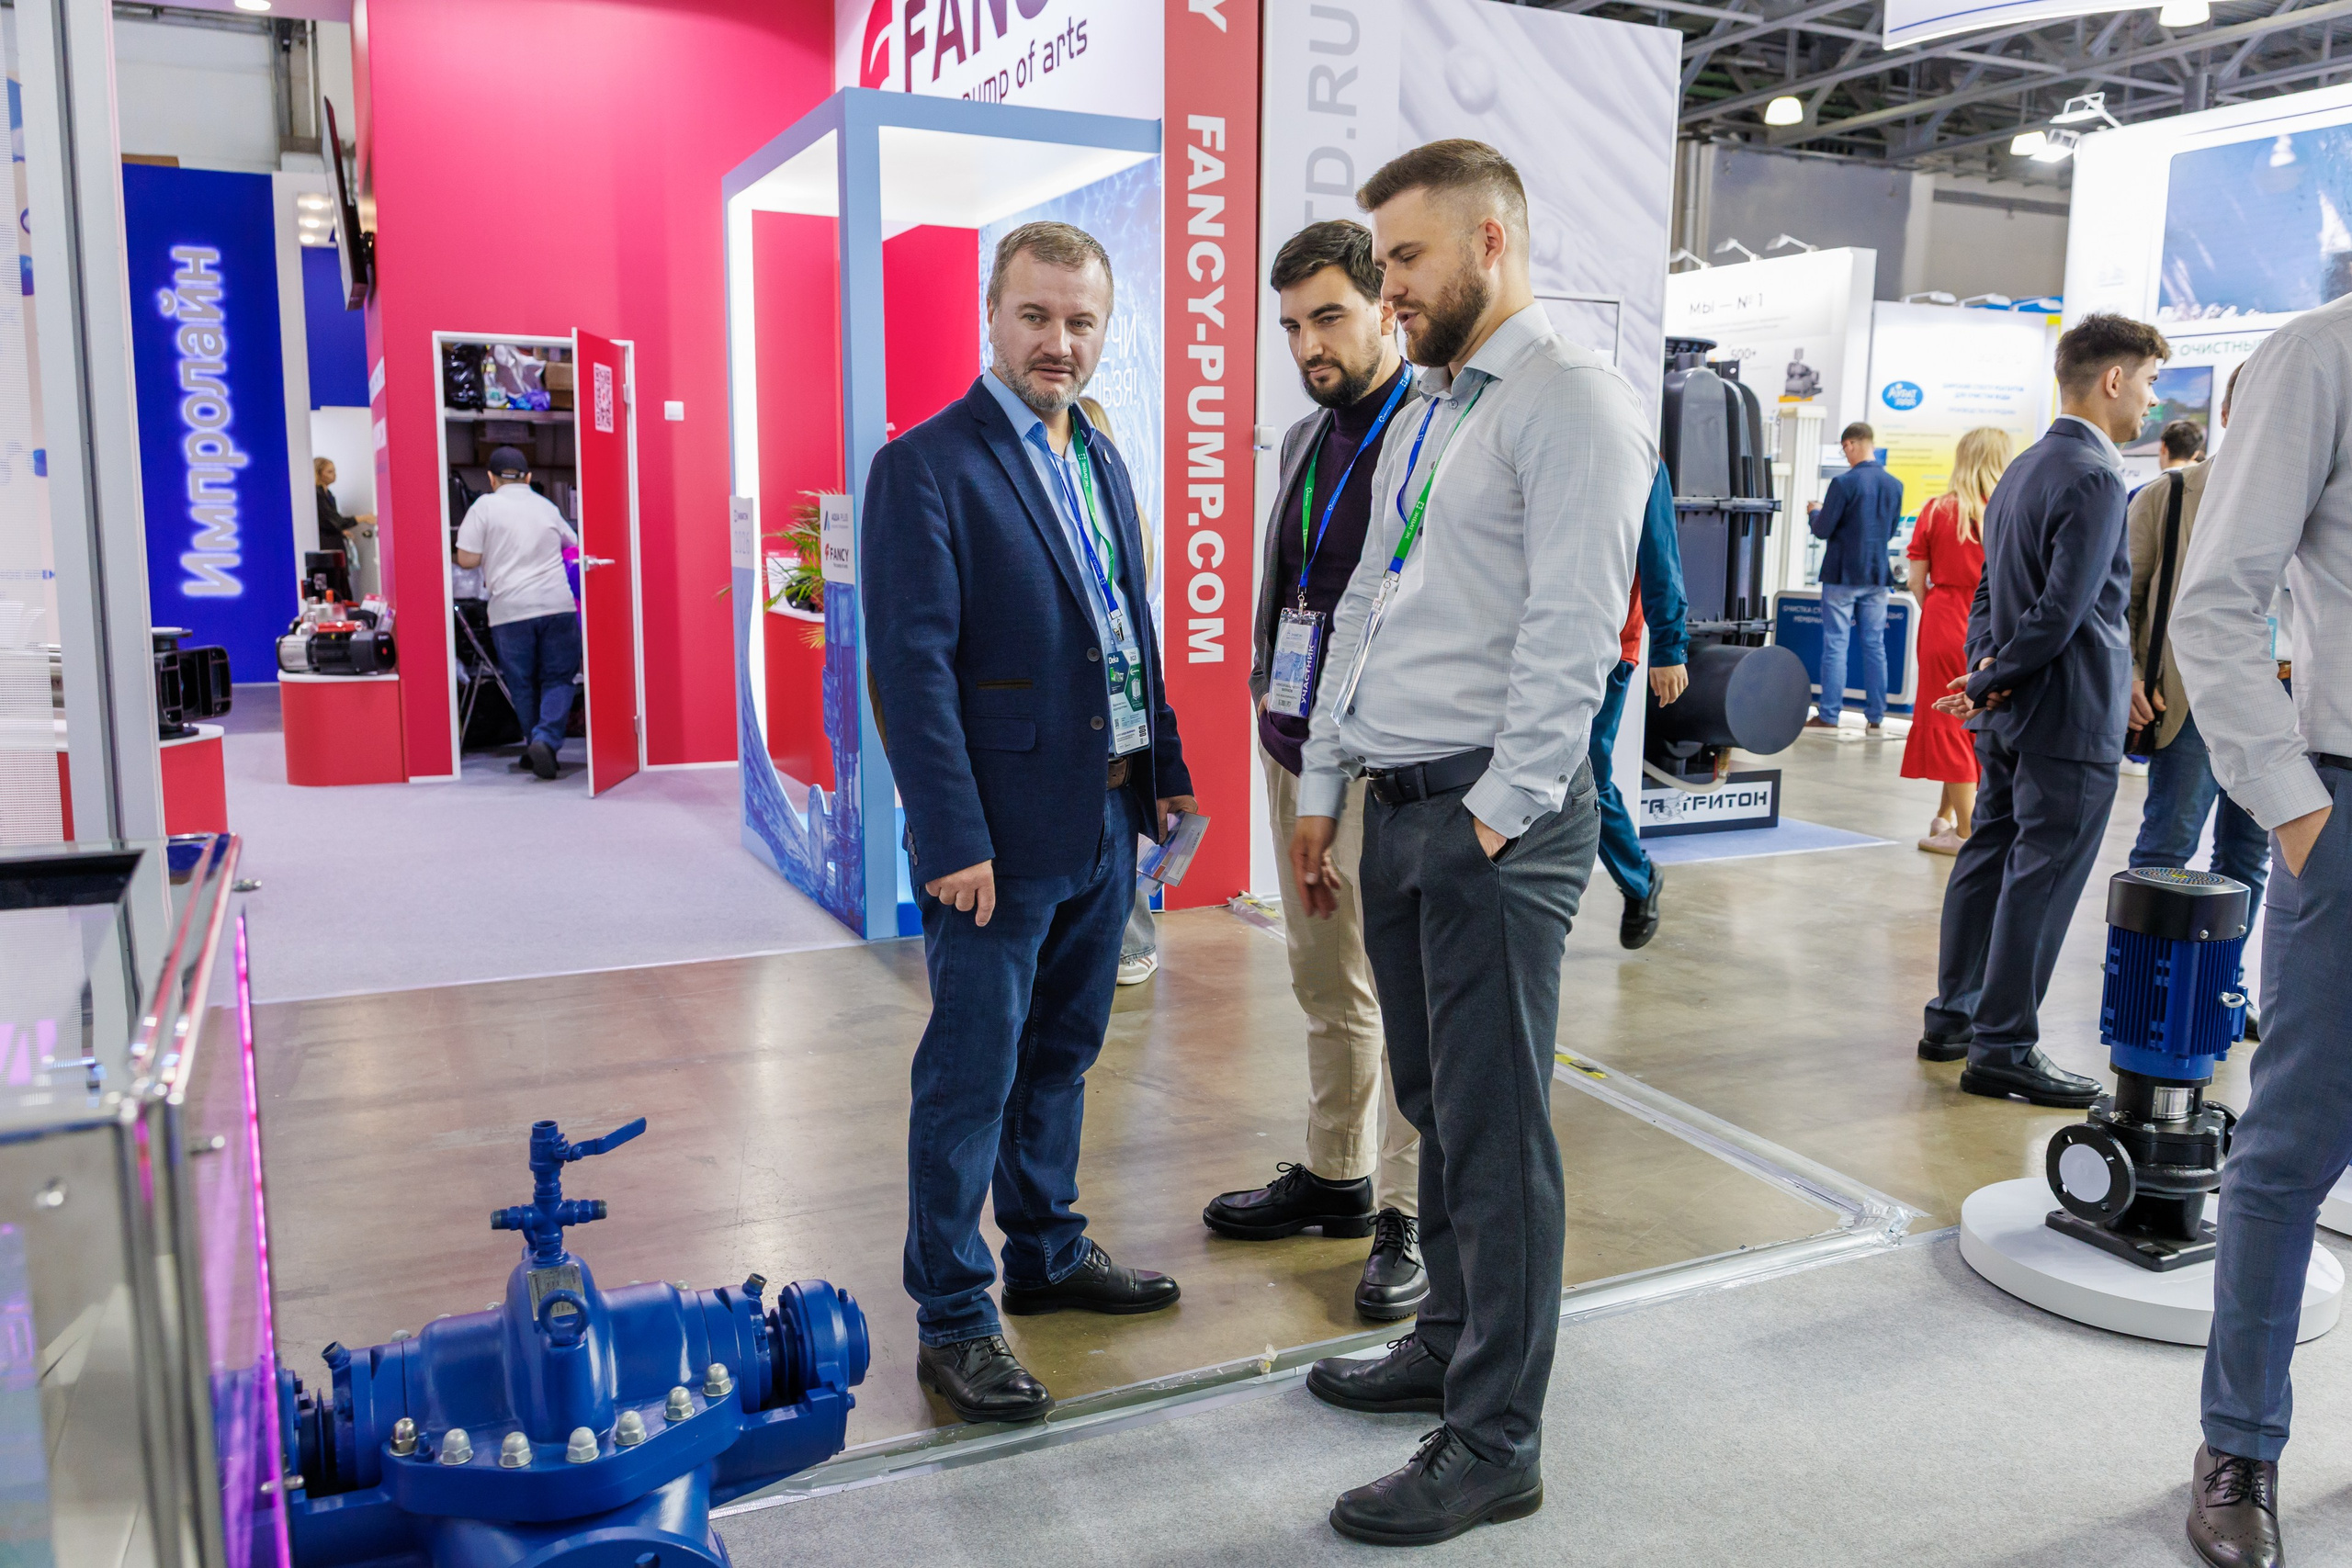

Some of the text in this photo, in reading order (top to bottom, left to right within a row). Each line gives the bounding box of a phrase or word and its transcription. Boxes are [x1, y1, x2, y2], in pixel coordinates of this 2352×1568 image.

[905, 0, 1049, 94] FAN
[962, 17, 1088, 104] ump of arts
[158, 246, 249, 598] Импролайн
[1187, 114, 1227, 663] FANCY-PUMP.COM
[830, 547, 849, 561] FANCY
[1301, 644, 1315, 705] УЧАСТНИК
[1682, 791, 1768, 811] ТРИТОН
